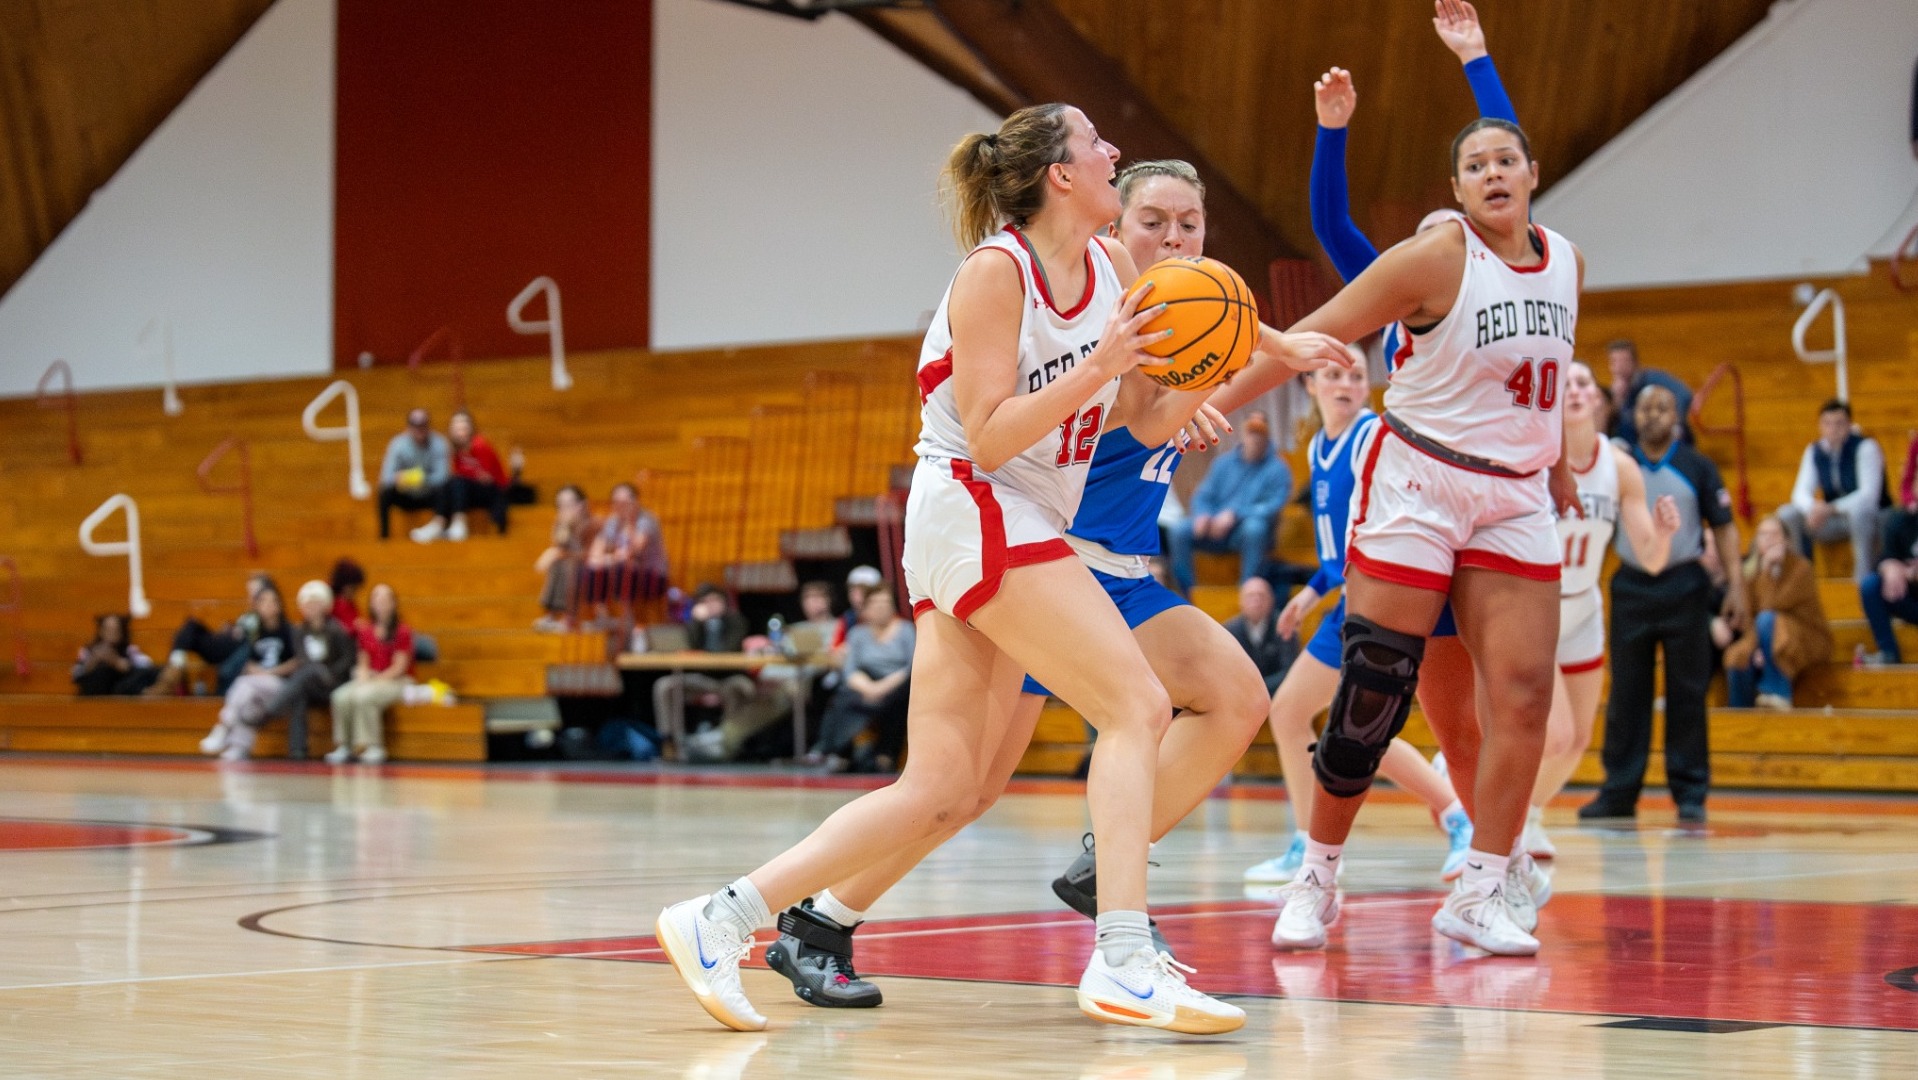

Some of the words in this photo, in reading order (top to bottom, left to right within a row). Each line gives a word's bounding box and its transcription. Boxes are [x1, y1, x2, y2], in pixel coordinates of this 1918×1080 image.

[1476, 301, 1517, 349] RED
[1524, 299, 1574, 346] DEVIL
[1504, 357, 1558, 412] 40
[1055, 403, 1104, 468] 12
[1317, 514, 1338, 561] 11
[1564, 532, 1590, 568] 11
